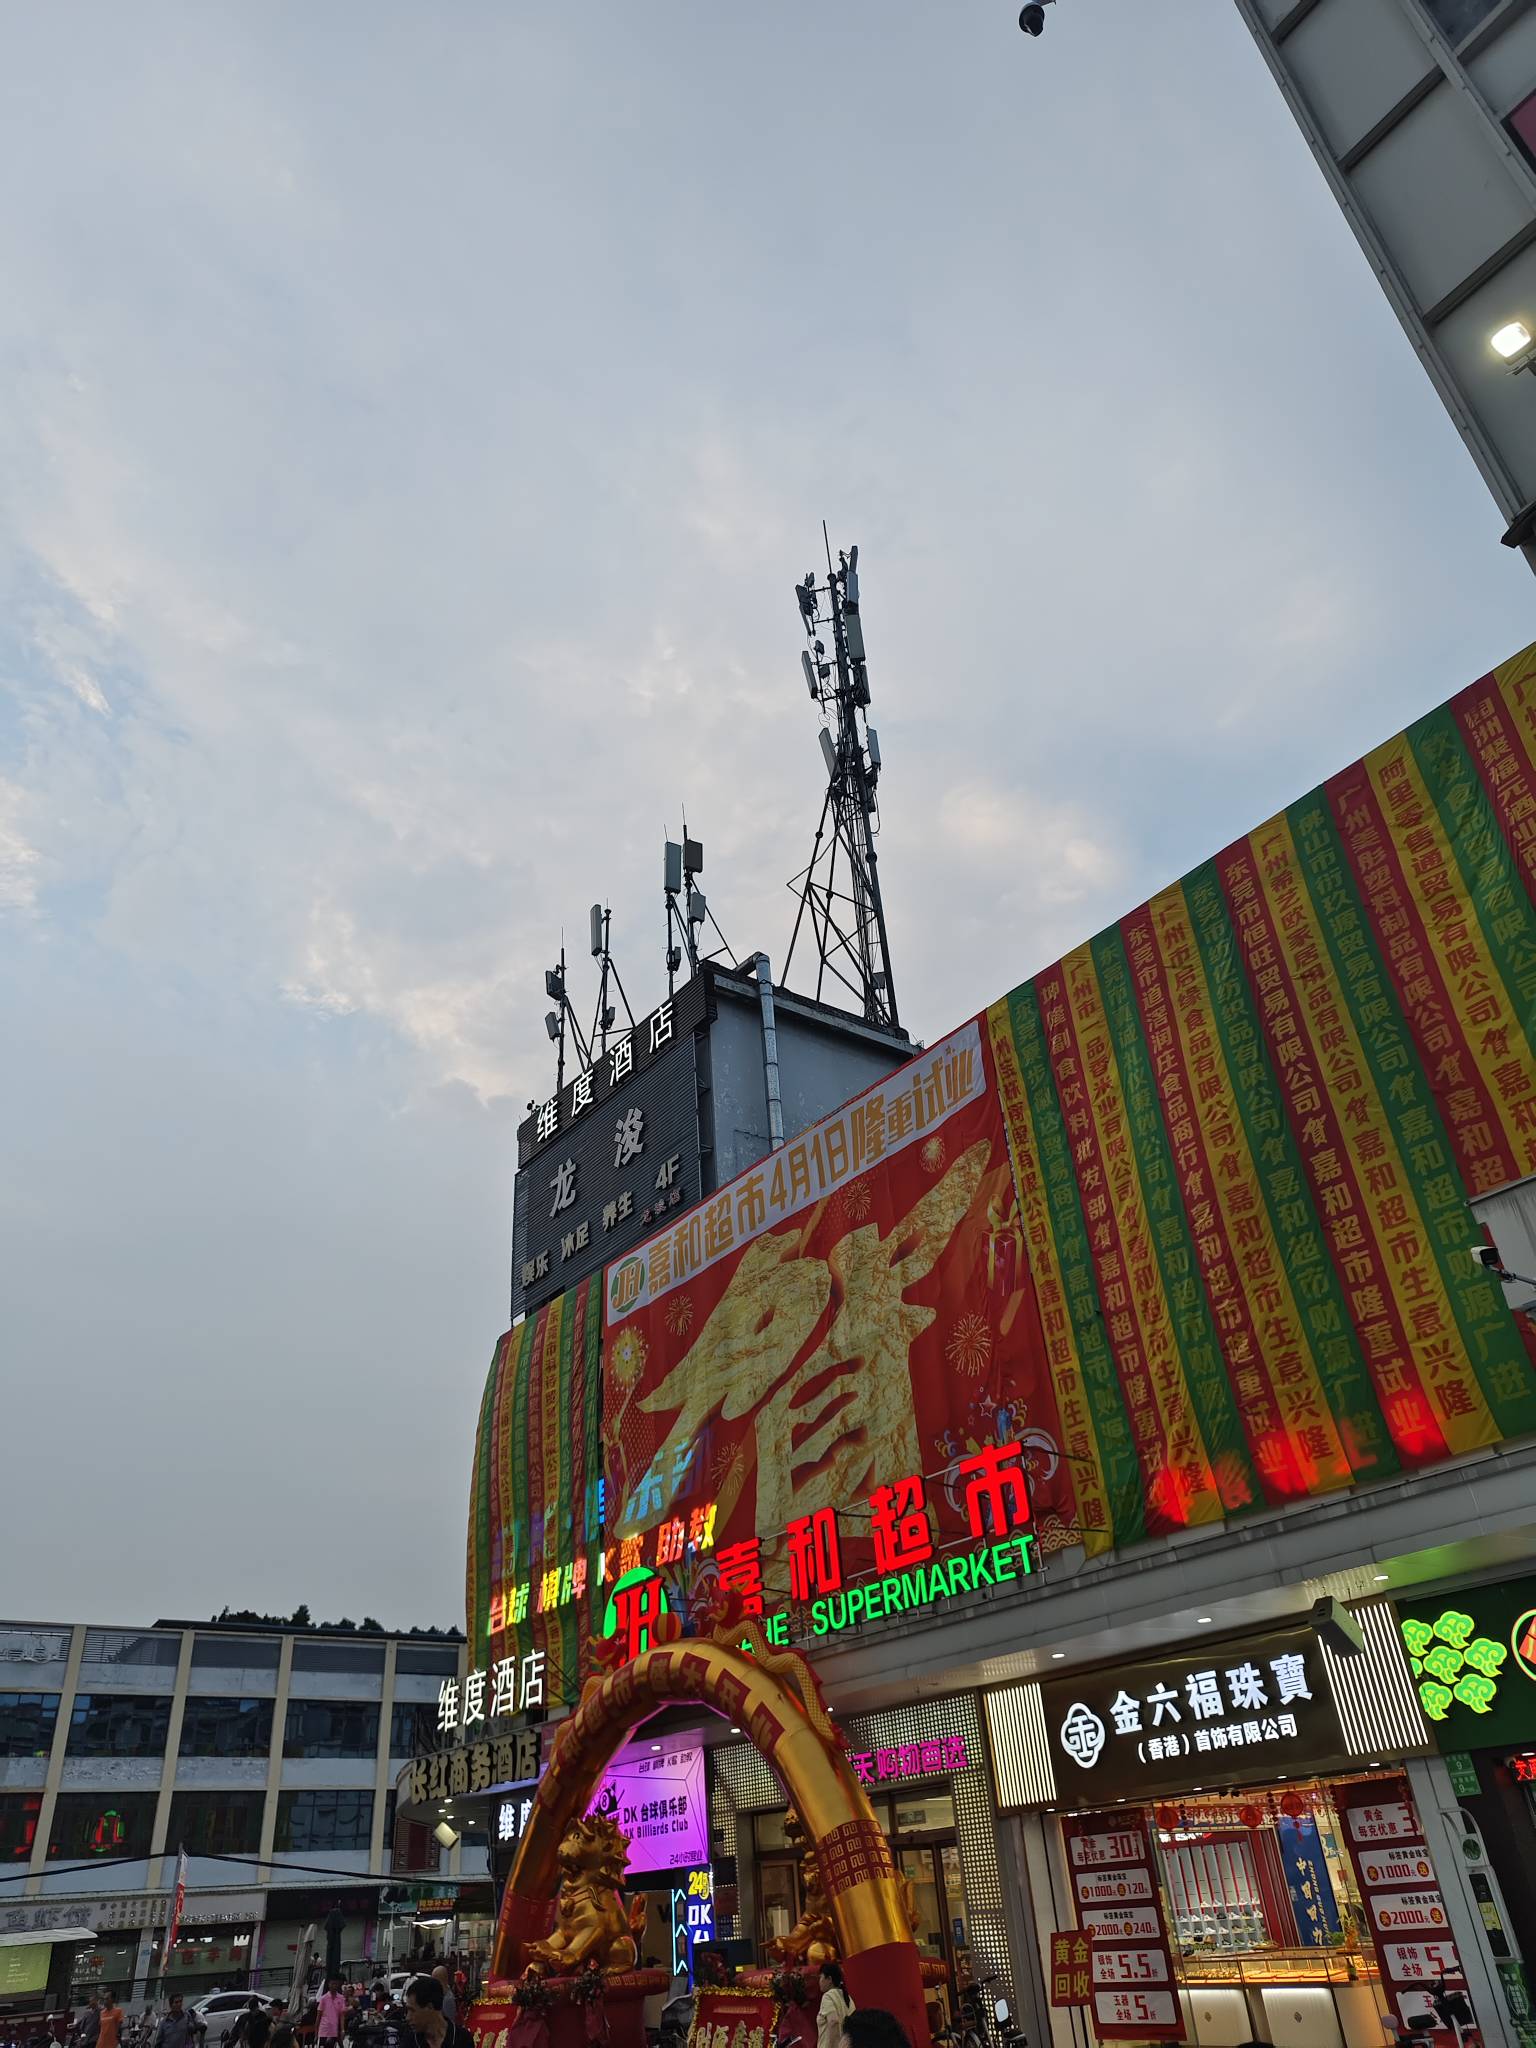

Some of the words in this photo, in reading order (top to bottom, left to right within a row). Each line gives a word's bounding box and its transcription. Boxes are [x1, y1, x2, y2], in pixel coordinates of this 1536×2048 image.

[536, 1001, 675, 1142] 维度酒店
[648, 1044, 976, 1295] 嘉和超市4月1日隆重试业
[602, 1190, 634, 1232] 养生
[656, 1154, 681, 1190] 4F
[715, 1441, 1034, 1617] 嘉和超市
[811, 1534, 1035, 1636] SUPERMARKET
[437, 1648, 545, 1733] 维度酒店
[1110, 1652, 1313, 1736] 金六福珠寶
[409, 1730, 538, 1805] 长红商务酒店
[624, 1804, 638, 1824] DK
[640, 1796, 688, 1822] 台球俱乐部
[1363, 1808, 1384, 1822] 黄金
[672, 1819, 688, 1833] Club
[1358, 1821, 1399, 1838] 每克优惠
[688, 1903, 712, 1926] DK
[1054, 1938, 1089, 1966] 黄金
[1396, 1946, 1418, 1960] 银饰
[1101, 1968, 1116, 1980] 全场
[1401, 1962, 1424, 1977] 全场
[1054, 1974, 1090, 2000] 回收
[1116, 2009, 1132, 2021] 全场
